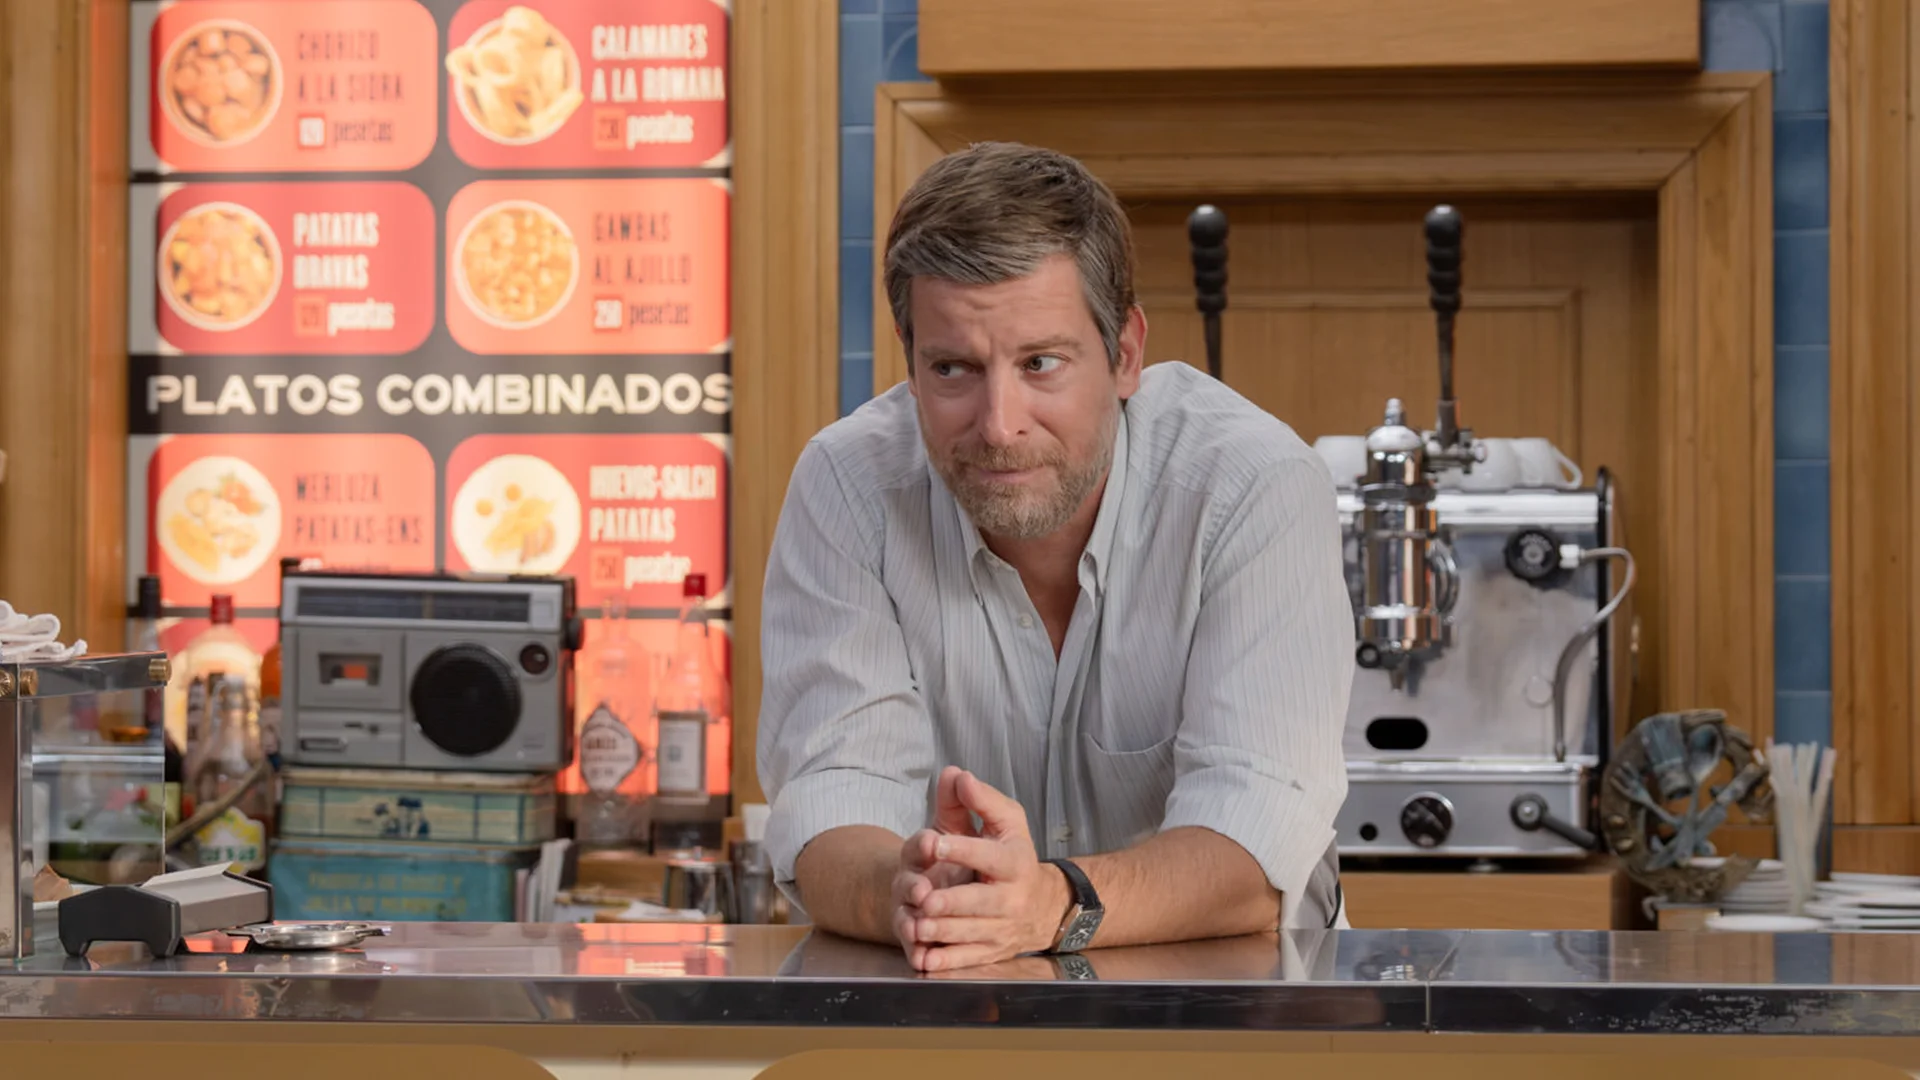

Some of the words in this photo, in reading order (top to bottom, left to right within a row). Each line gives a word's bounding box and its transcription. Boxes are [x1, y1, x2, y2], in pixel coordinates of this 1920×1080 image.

[297, 31, 379, 61] CHORIZO
[592, 24, 708, 60] CALAMARES
[297, 73, 306, 102] A
[315, 73, 338, 103] LA
[591, 67, 607, 102] A
[611, 67, 638, 102] LA
[642, 67, 726, 102] ROMANA
[332, 119, 393, 148] pesetas
[626, 110, 694, 150] pesetas
[293, 211, 379, 247] PATATAS
[594, 211, 669, 241] GAMBAS
[293, 254, 369, 290] BRAVAS
[327, 297, 395, 337] pesetas
[629, 299, 689, 329] pesetas
[147, 373, 362, 415] PLATOS
[376, 373, 731, 416] COMBINADOS
[296, 473, 380, 502] MERLUZA
[590, 508, 675, 543] PATATAS
